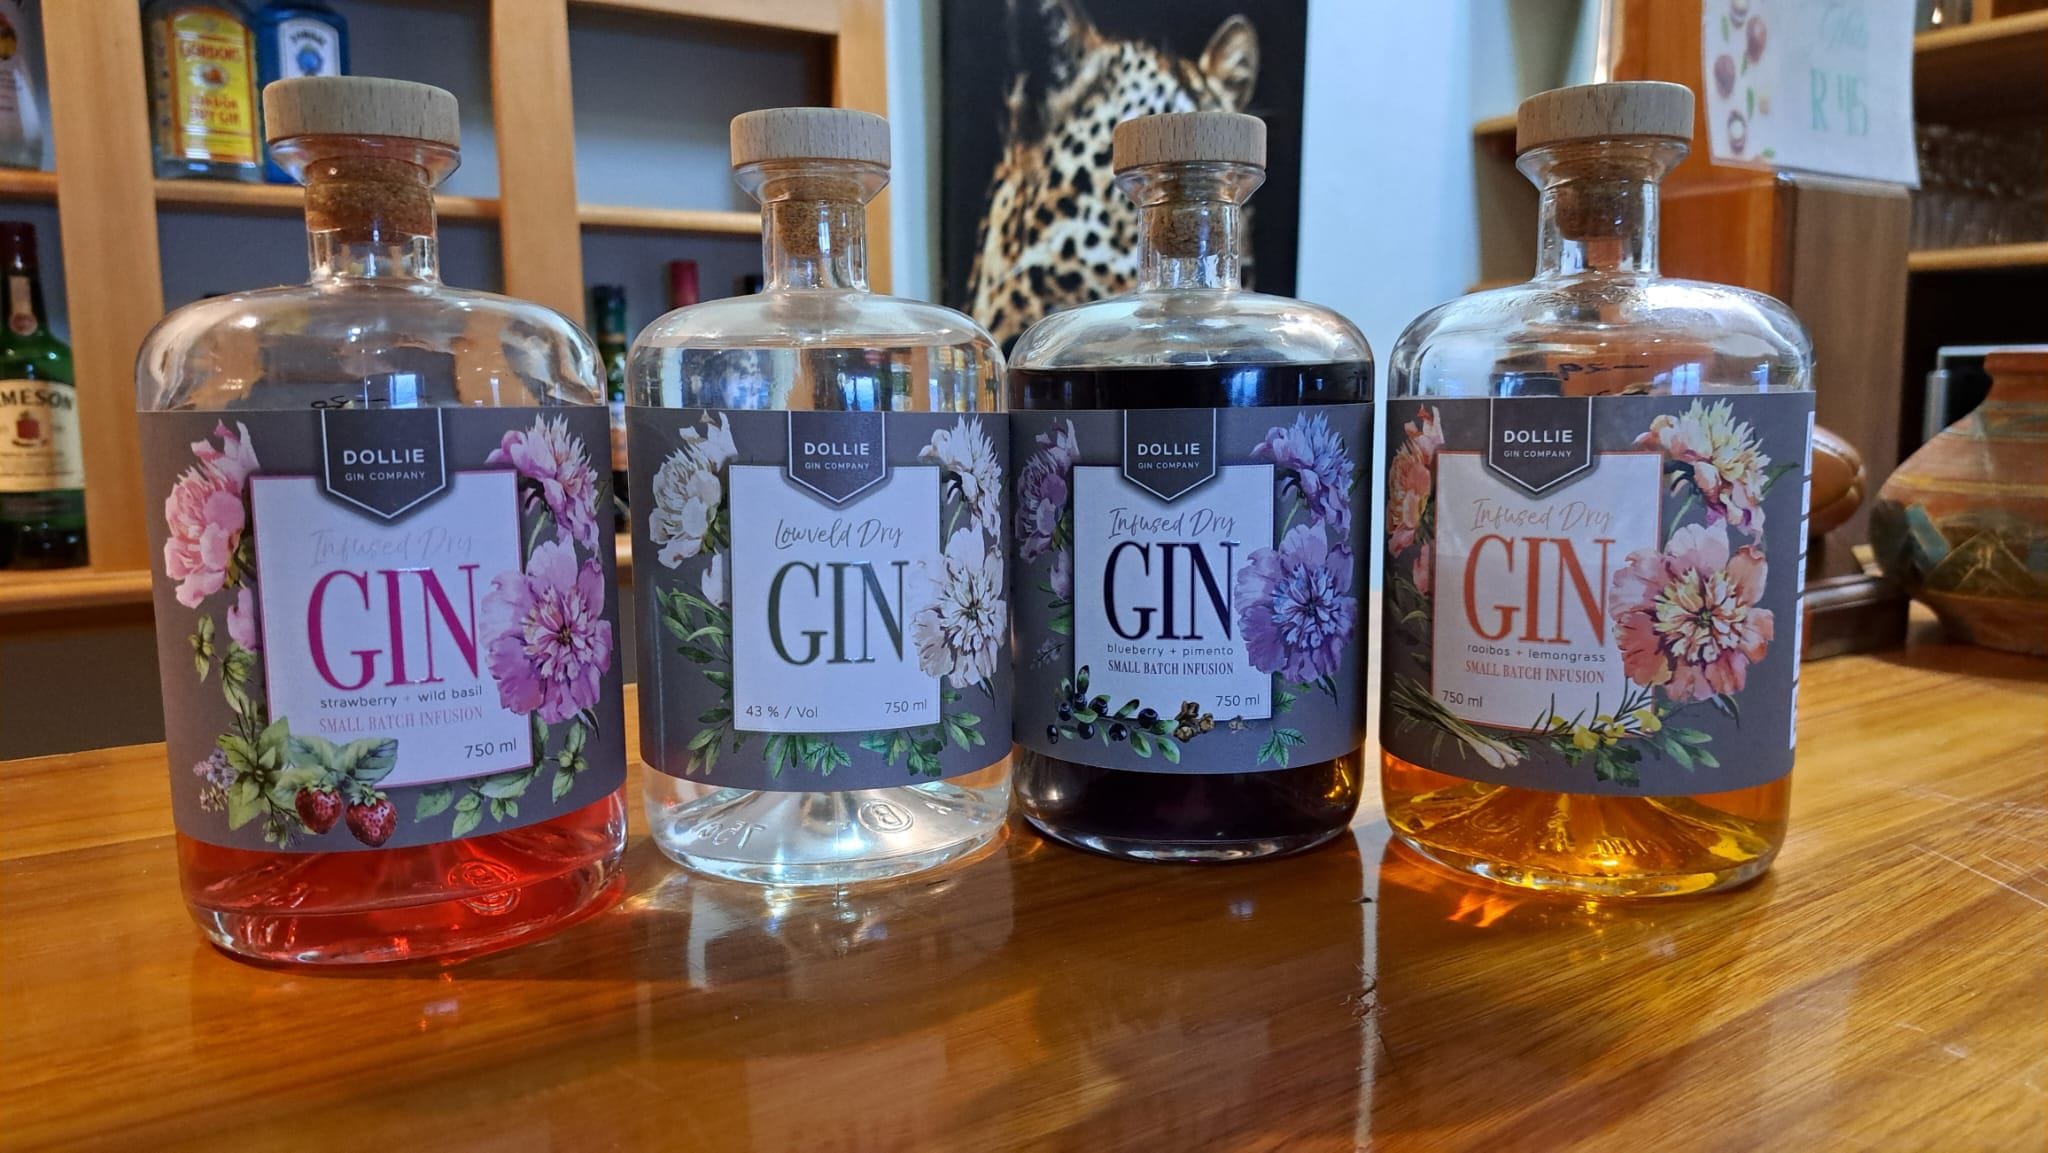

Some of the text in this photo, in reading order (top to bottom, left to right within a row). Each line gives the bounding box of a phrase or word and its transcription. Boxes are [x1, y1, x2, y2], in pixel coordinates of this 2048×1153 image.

[1504, 430, 1573, 443] DOLLIE
[343, 449, 425, 465] DOLLIE
[804, 442, 870, 456] DOLLIE
[1138, 443, 1200, 456] DOLLIE
[1504, 450, 1572, 458] GIN COMPANY
[804, 462, 870, 471] GIN COMPANY
[1138, 461, 1200, 470] GIN COMPANY
[345, 471, 425, 482] GIN COMPANY
[1108, 507, 1236, 539] Infused Dry
[1470, 498, 1615, 531] Infused Dry
[775, 518, 903, 549] Lowveld Dry
[310, 527, 472, 567] Infused Dry
[1103, 539, 1241, 642] GIN
[1463, 534, 1616, 647] GIN
[767, 559, 910, 666] GIN
[307, 564, 480, 691] GIN
[1107, 643, 1163, 657] blueberry
[1182, 646, 1234, 657] pimento
[1467, 644, 1511, 656] rooibos
[1528, 648, 1606, 663] lemongrass
[1108, 659, 1234, 675] SMALL BATCH INFUSION
[1465, 660, 1605, 684] SMALL BATCH INFUSION
[320, 695, 398, 709] strawberry
[418, 690, 447, 703] wild
[451, 686, 483, 698] basil
[884, 699, 927, 714] 750 ml
[1215, 693, 1260, 707] 750 ml
[1442, 690, 1483, 708] 750 ml
[320, 706, 483, 733] SMALL BATCH INFUSION
[745, 705, 818, 719] 43 % / Vol
[464, 738, 517, 759] 750 ml
